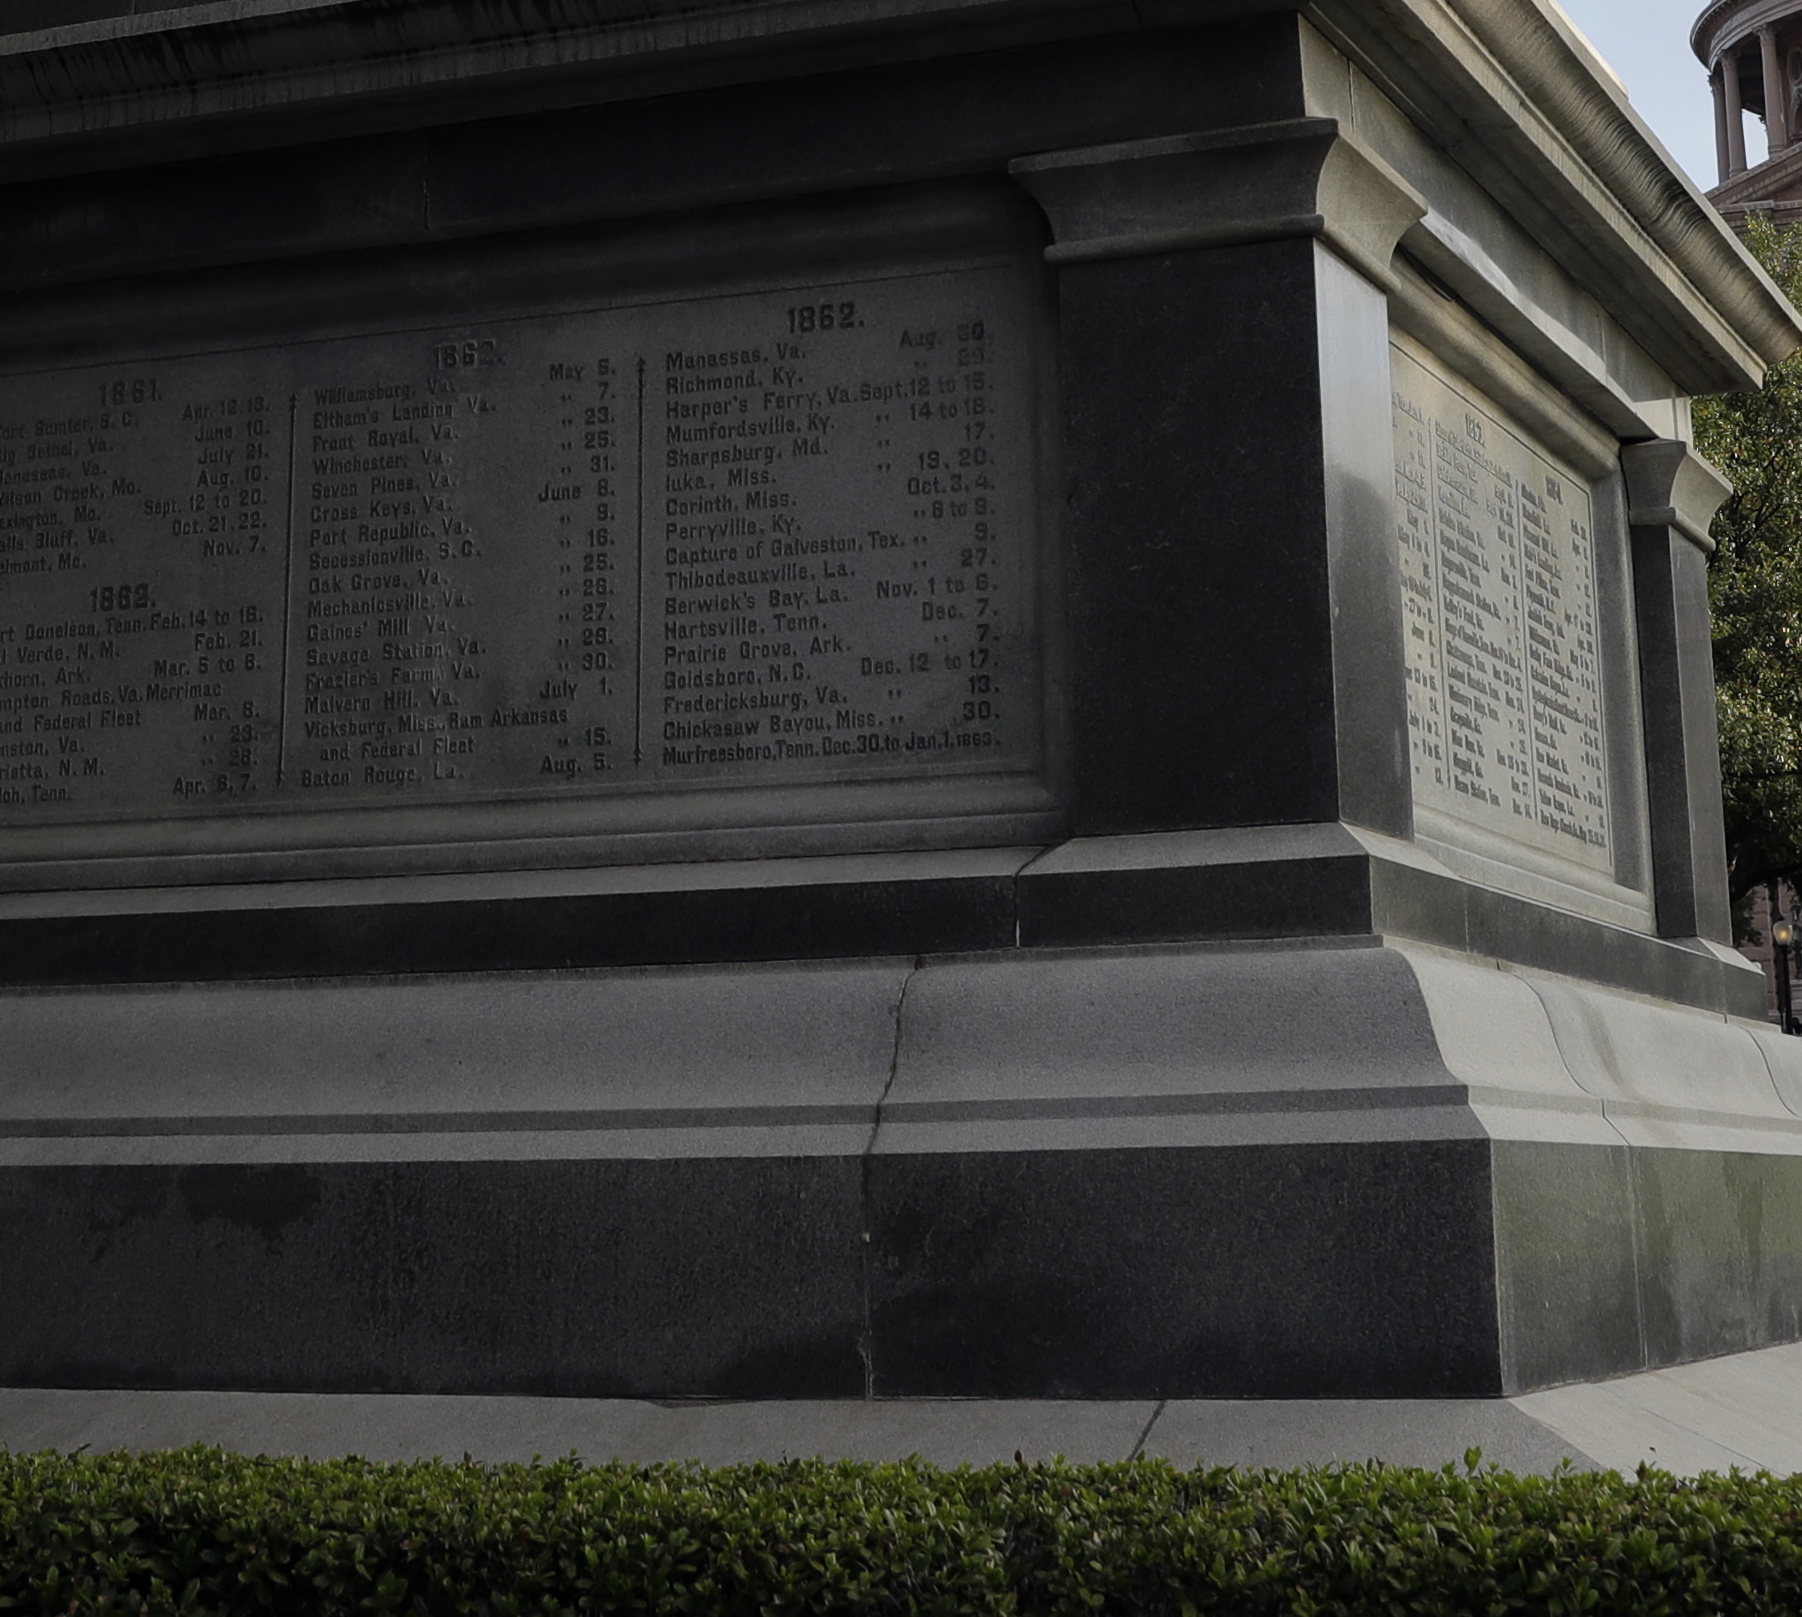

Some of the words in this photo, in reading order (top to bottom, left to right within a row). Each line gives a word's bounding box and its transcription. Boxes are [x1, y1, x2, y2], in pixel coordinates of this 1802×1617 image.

[787, 302, 865, 333] 1862.
[777, 343, 806, 360] Va.
[549, 364, 584, 383] May
[773, 367, 803, 388] Ky.
[100, 378, 163, 406] 1861.
[666, 396, 748, 419] Harper's
[827, 385, 858, 404] Va.
[313, 406, 379, 430] Eltham's
[393, 402, 454, 422] Landing
[808, 414, 835, 435] Ky.
[965, 398, 994, 416] 16.
[195, 423, 233, 442] June
[247, 421, 269, 436] 10.
[313, 435, 354, 453] Front
[793, 438, 828, 457] Md.
[965, 422, 994, 441] 17.
[198, 448, 234, 466] July
[246, 443, 269, 459] 21.
[112, 479, 142, 495] Mo.
[198, 471, 234, 488] Aug.
[244, 466, 268, 482] 10.
[311, 482, 358, 500] Seven
[590, 456, 615, 473] 31.
[728, 468, 776, 487] Miss.
[144, 498, 182, 516] Sept.
[240, 489, 267, 505] 20.
[310, 505, 358, 523] Cross
[538, 484, 582, 503] June
[746, 491, 796, 510] Miss.
[908, 476, 946, 496] Oct.
[773, 514, 801, 534] Ky.
[204, 539, 240, 557] Nov.
[250, 535, 266, 553] 7.
[309, 529, 347, 547] Port
[666, 546, 737, 567] Capture
[747, 540, 764, 559] of
[868, 531, 904, 549] Tex.
[824, 560, 855, 578] La.
[961, 547, 996, 567] 27.
[90, 583, 157, 612] 1862.
[309, 576, 342, 595] Oak
[666, 592, 756, 615] Berwick's
[816, 585, 848, 604] La.
[876, 580, 918, 599] Nov.
[151, 612, 185, 630] Feb.
[583, 603, 615, 622] 27.
[774, 613, 827, 632] Tenn.
[922, 601, 964, 621] Dec.
[977, 598, 997, 616] 7.
[194, 633, 231, 651] Feb.
[240, 631, 262, 647] 21.
[665, 644, 726, 665] Prairie
[810, 635, 851, 655] Ark.
[307, 648, 370, 666] Savage
[769, 664, 790, 682] N.
[793, 662, 811, 680] C.
[861, 656, 901, 676] Dec.
[56, 667, 91, 684] Ark.
[154, 660, 190, 677] Mar.
[305, 668, 379, 691] Frazier's
[147, 682, 222, 701] Merrimac
[305, 696, 371, 714] Malvern
[540, 680, 578, 700] July
[816, 685, 847, 705] Va.
[34, 711, 92, 731] Federal
[101, 710, 142, 727] Fleet
[194, 703, 231, 721] Mar.
[450, 711, 483, 730] Ram
[491, 707, 568, 727] Arkansas
[664, 717, 760, 740] Chickasaw
[836, 710, 883, 730] Miss.
[963, 701, 1000, 720] 30.
[59, 737, 85, 753] Va.
[320, 746, 350, 761] and
[361, 739, 422, 759] Federal
[434, 736, 475, 754] Fleet
[302, 769, 350, 788] Baton
[541, 756, 582, 778] Aug.
[32, 784, 72, 802] Tenn.
[173, 777, 206, 795] Apr.
